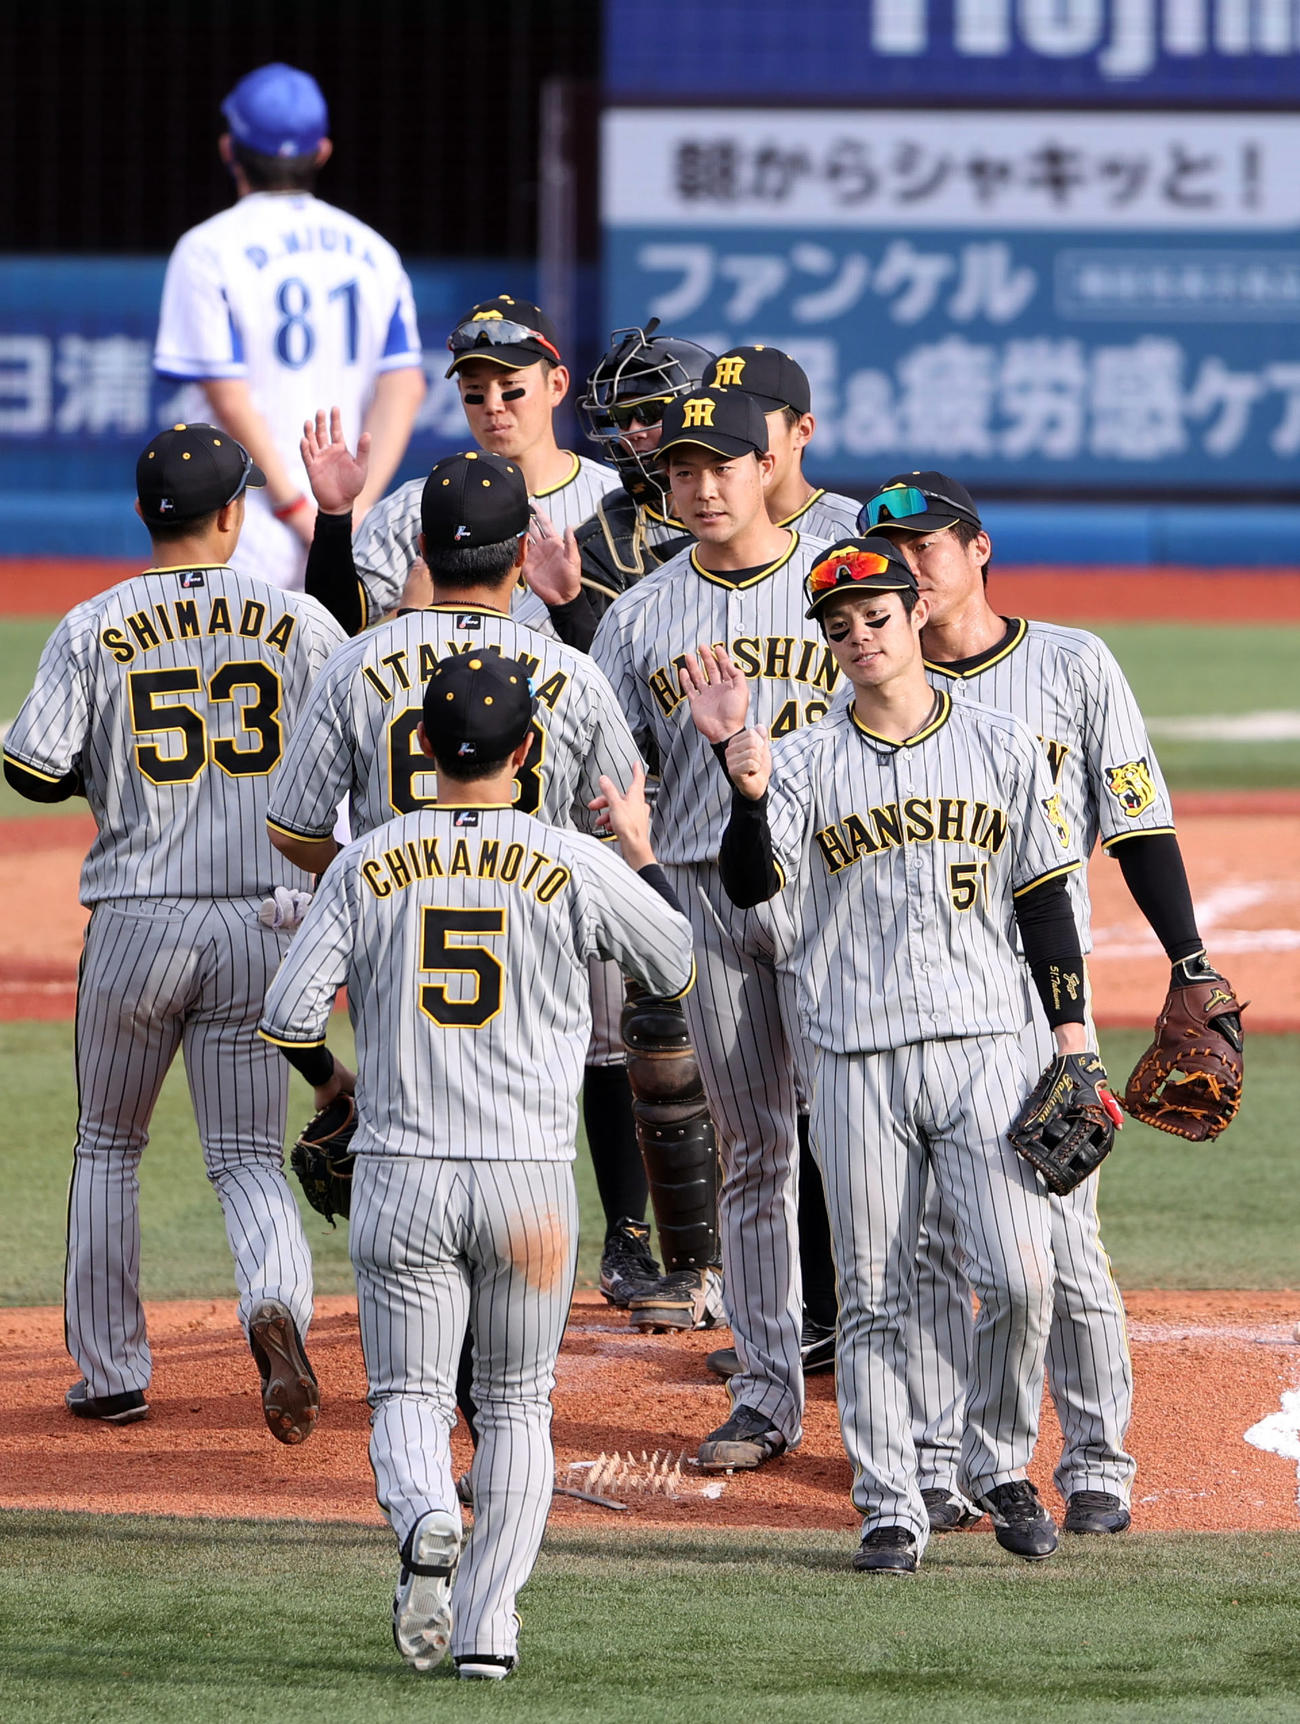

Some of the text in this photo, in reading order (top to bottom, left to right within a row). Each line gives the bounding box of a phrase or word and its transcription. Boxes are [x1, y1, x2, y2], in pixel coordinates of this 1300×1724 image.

[637, 238, 1038, 324] ファンケル
[273, 276, 361, 370] 81
[101, 597, 298, 665] SHIMADA
[361, 640, 571, 713] ITAMA
[649, 636, 842, 718] HSHIN
[126, 660, 284, 785] 53
[361, 837, 571, 905] CHIKAMOTO
[815, 797, 1008, 875] HANSHIN
[419, 906, 506, 1029] 5
